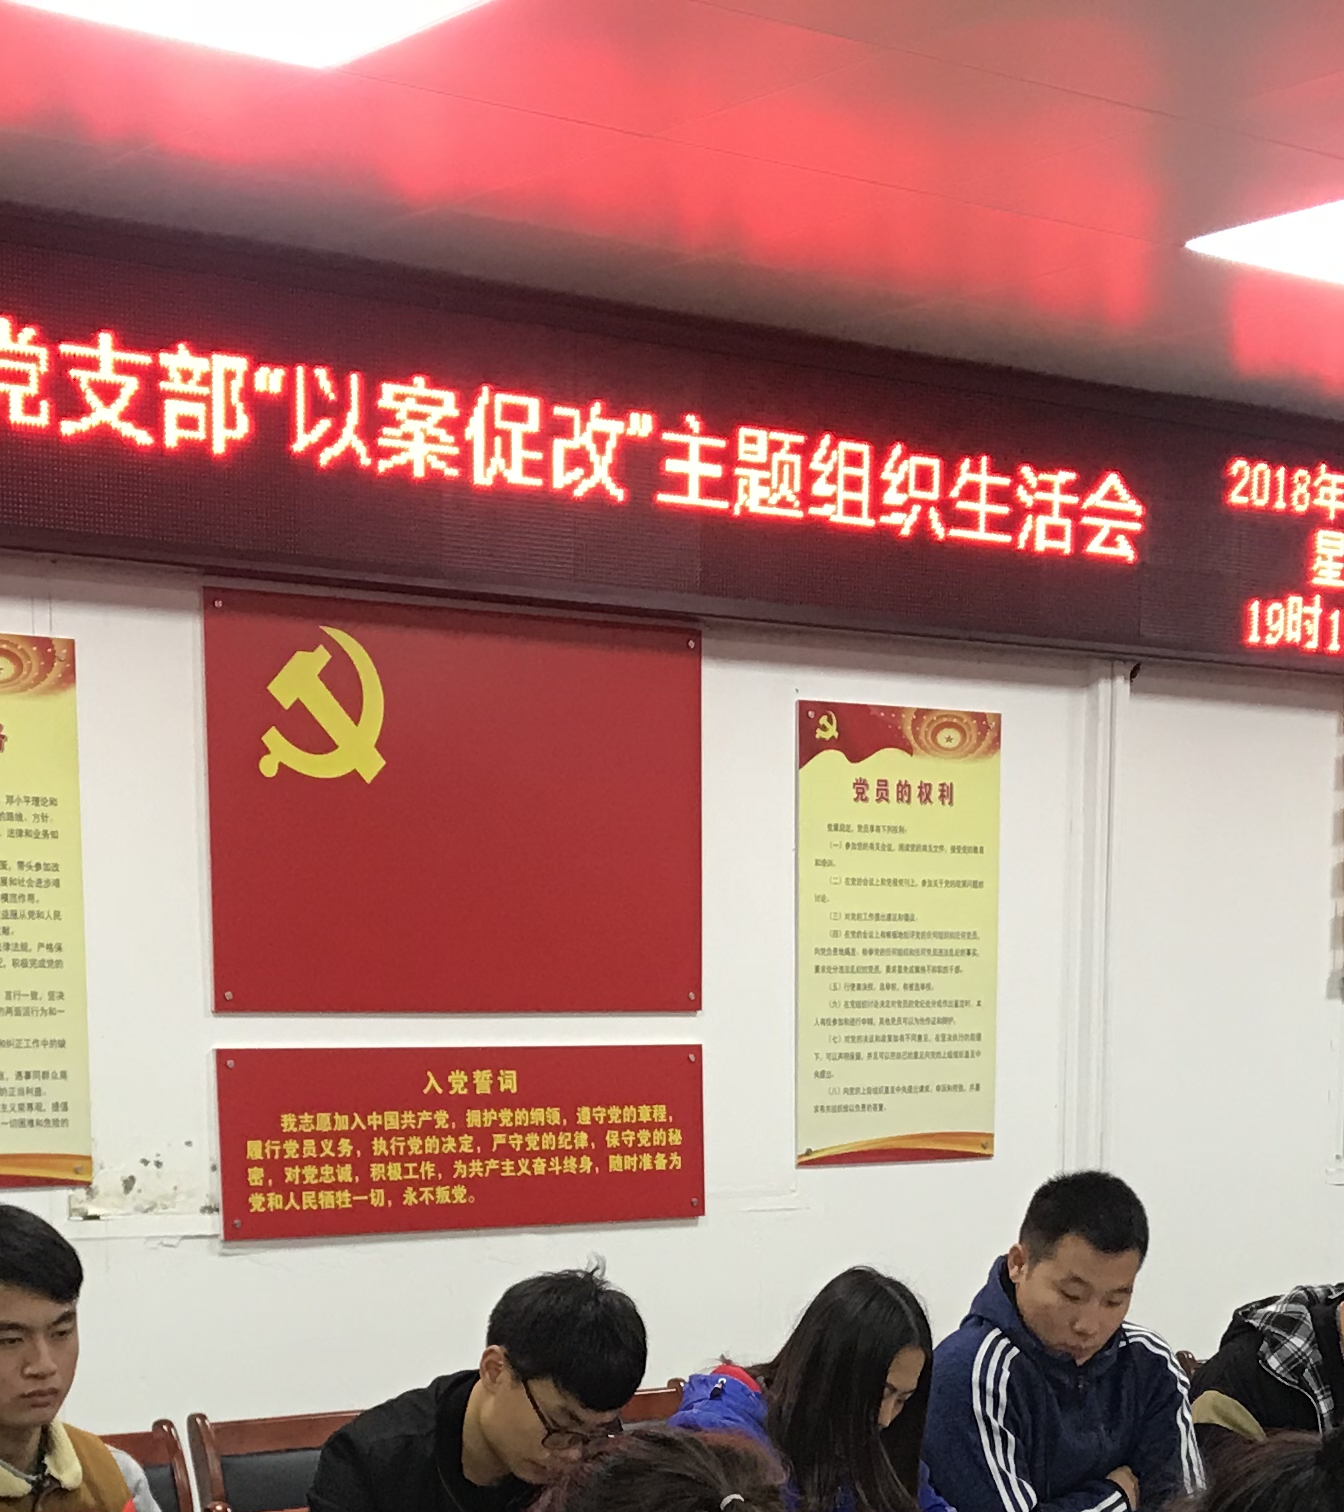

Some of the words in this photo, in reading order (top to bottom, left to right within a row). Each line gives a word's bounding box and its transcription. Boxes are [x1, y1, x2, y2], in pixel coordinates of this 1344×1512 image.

[852, 777, 954, 806] 党员的权利
[423, 1070, 517, 1095] 入党誓词
[280, 1104, 674, 1133] 我志愿加入中国共产党，拥护党的纲领，遵守党的章程，
[246, 1128, 683, 1160] 履行党员义务，执行党的决定，严守党的纪律，保守党的秘
[247, 1152, 682, 1187] 密，对党忠诚，积极工作，为共产主义奋斗终身，随时准备为
[248, 1184, 476, 1213] 党和人民牺牲一切，永不叛党。
